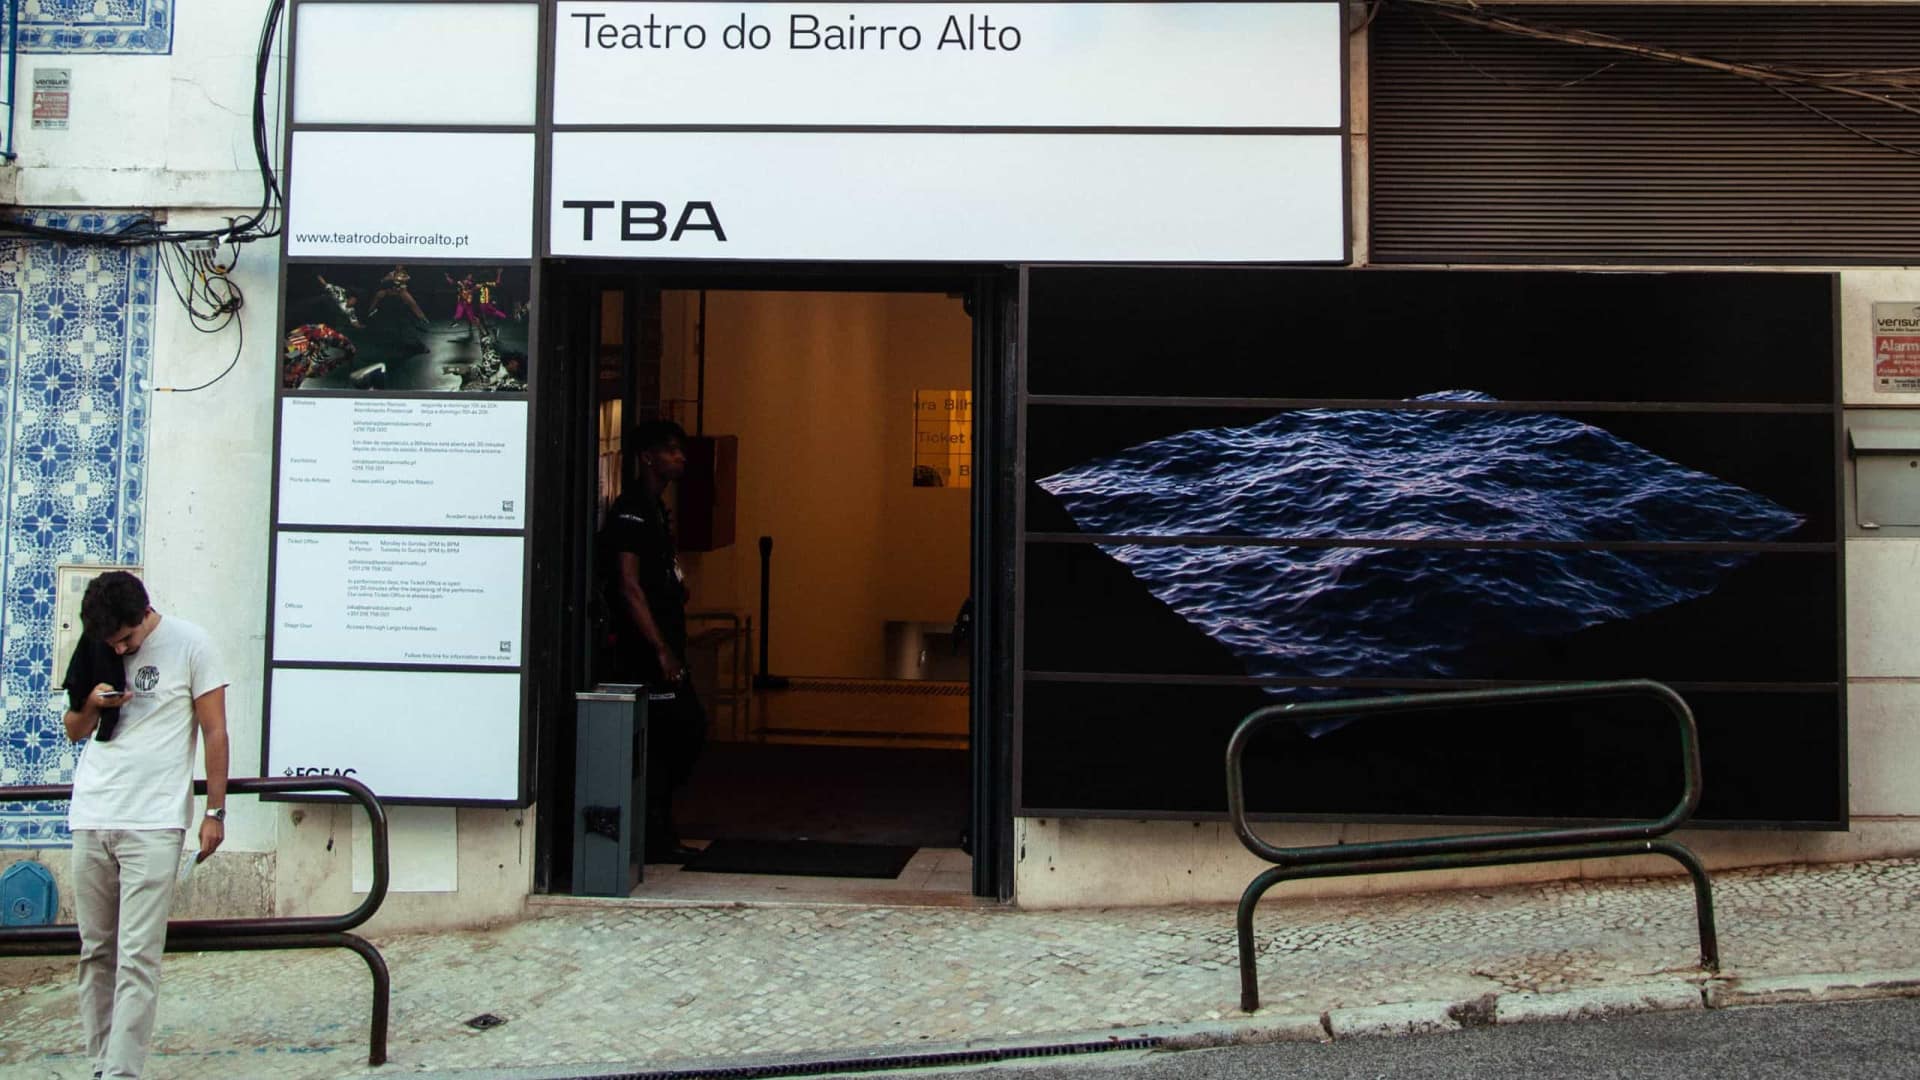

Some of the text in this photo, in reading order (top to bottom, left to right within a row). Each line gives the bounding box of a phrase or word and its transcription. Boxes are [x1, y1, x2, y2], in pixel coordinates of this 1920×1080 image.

[571, 13, 1022, 51] Teatro do Bairro Alto
[563, 200, 727, 242] TBA
[296, 232, 469, 248] www.teatrodobairroalto.pt
[1880, 339, 1920, 352] Alarm
[918, 431, 965, 443] Ticket
